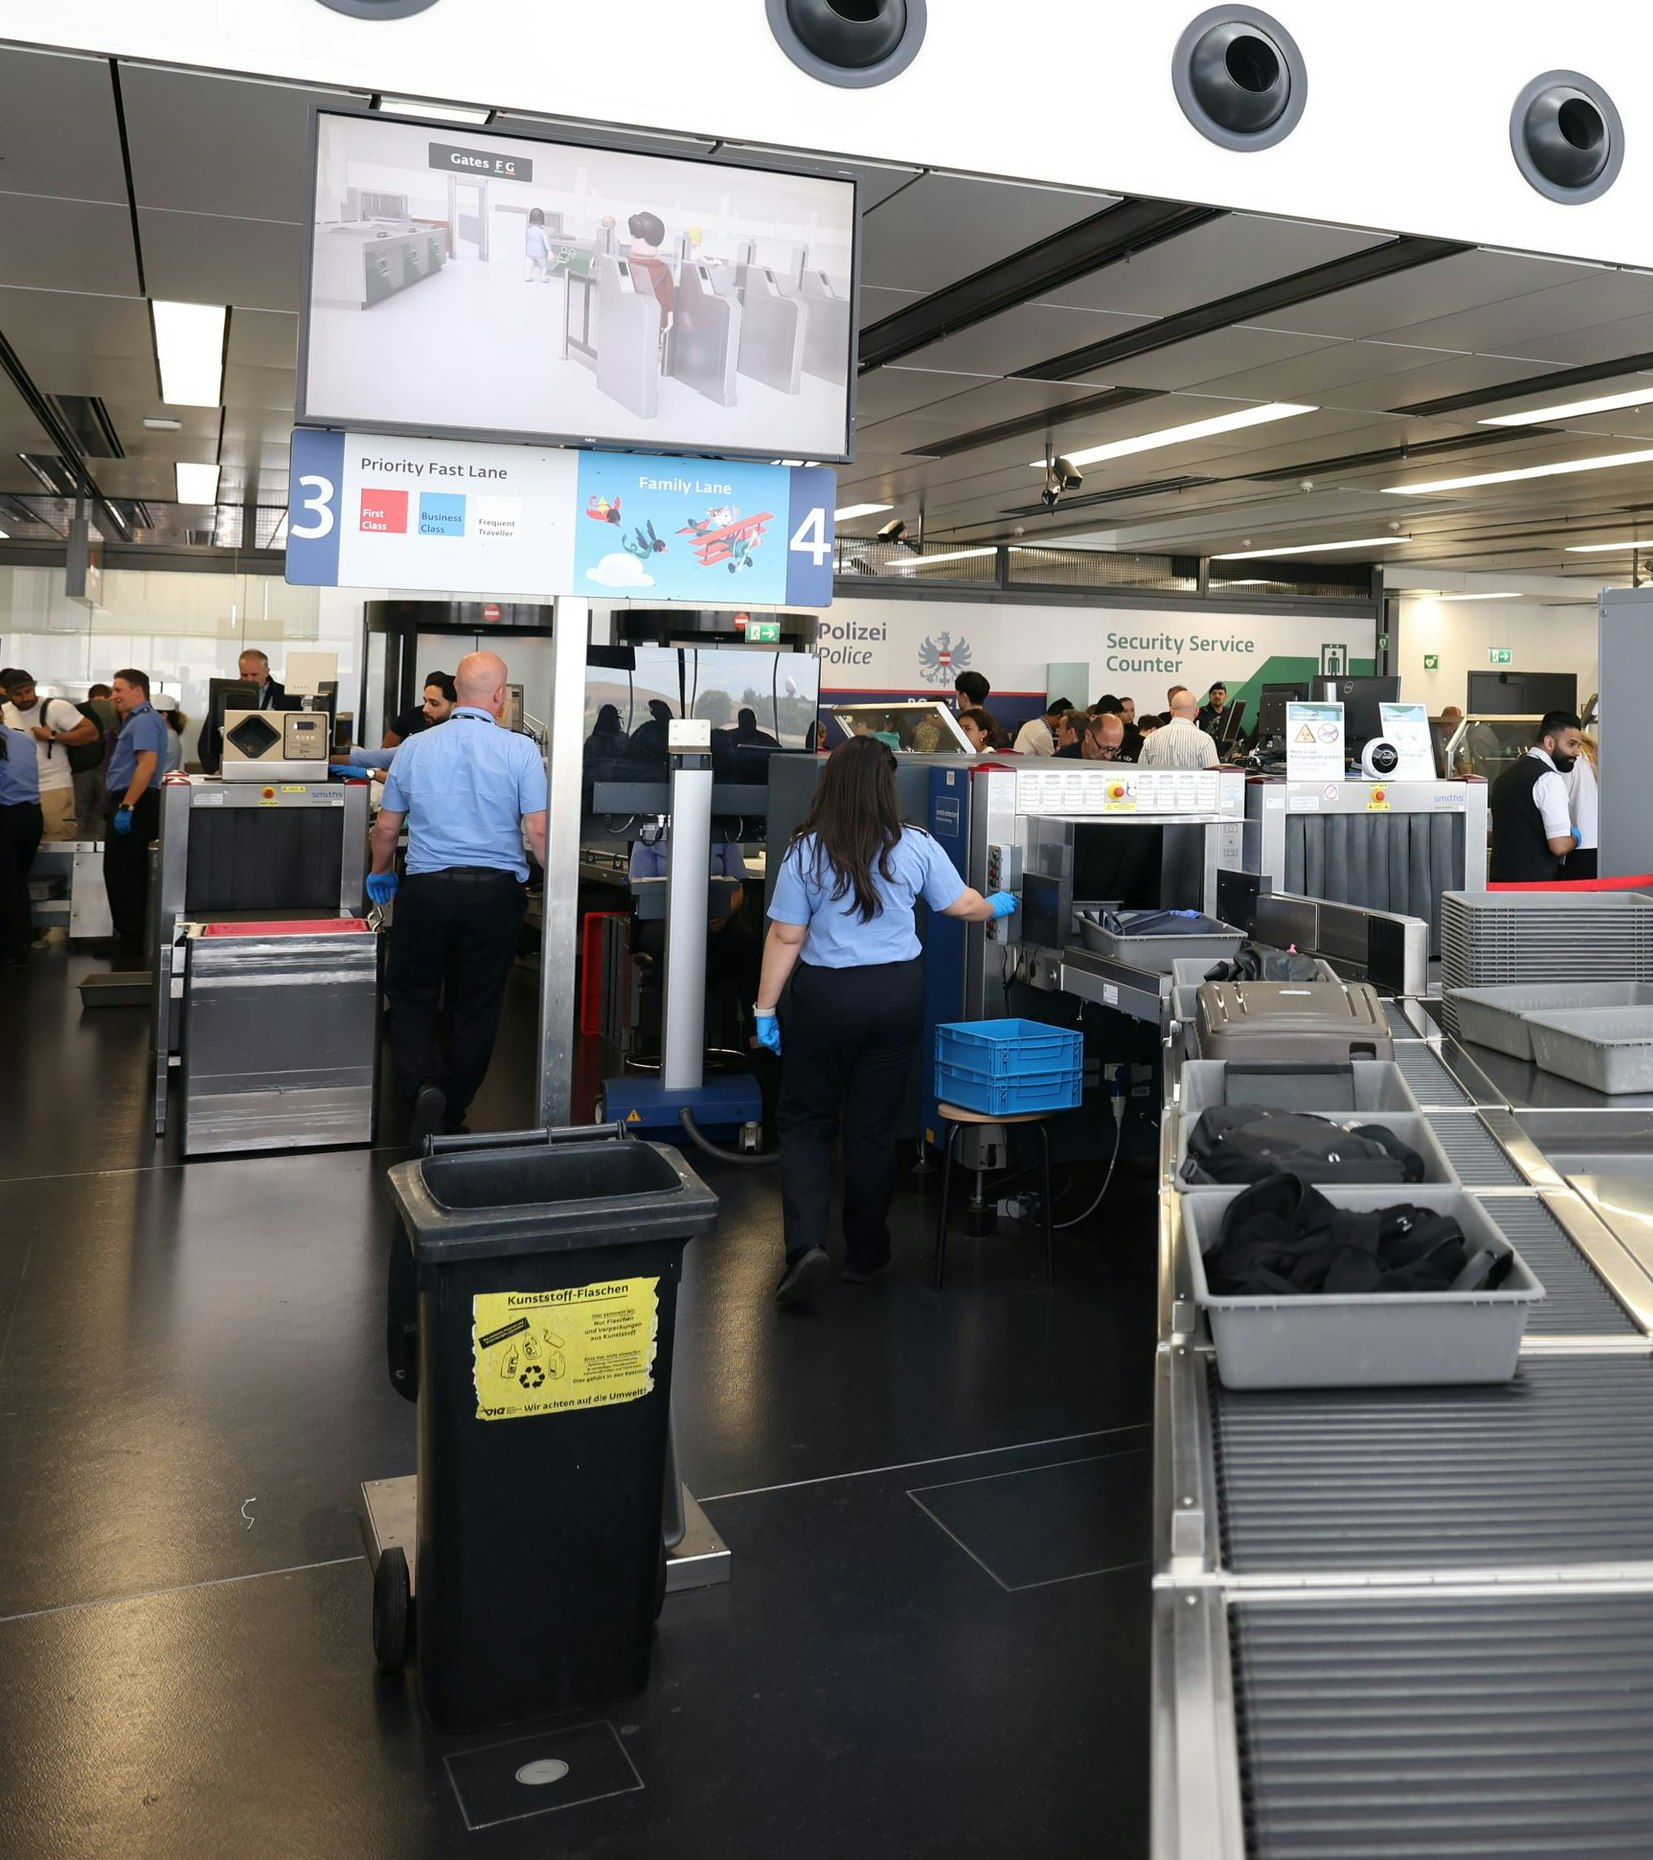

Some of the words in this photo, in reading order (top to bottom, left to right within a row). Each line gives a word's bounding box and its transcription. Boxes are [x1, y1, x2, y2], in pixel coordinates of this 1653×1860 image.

[450, 153, 490, 169] Gates
[495, 160, 503, 170] F
[505, 162, 515, 172] G
[361, 458, 424, 476] Priority
[429, 462, 464, 477] Fast
[469, 465, 508, 480] Lane
[638, 476, 692, 494] Family
[696, 480, 732, 496] Lane
[290, 474, 334, 539] 3
[363, 508, 384, 519] First
[421, 512, 462, 522] Business
[478, 518, 515, 528] Frequent
[362, 520, 387, 531] Class
[420, 524, 445, 534] Class
[478, 529, 514, 538] Traveller
[790, 507, 832, 566] 4
[819, 622, 886, 640] Polizei
[1106, 632, 1184, 654] Security
[1190, 635, 1254, 652] Service
[820, 646, 872, 664] Police
[1106, 656, 1182, 672] Counter
[1434, 794, 1464, 802] smiths
[508, 1284, 629, 1306] Kunststoff-Flaschen
[598, 1322, 642, 1334] Verpackungen
[606, 1316, 634, 1324] Flaschen
[603, 1330, 636, 1339] Kunststoff
[524, 1404, 540, 1412] Wir
[543, 1400, 574, 1410] achten
[577, 1396, 592, 1406] auf
[593, 1393, 608, 1402] die
[609, 1388, 647, 1400] Umwelt!
